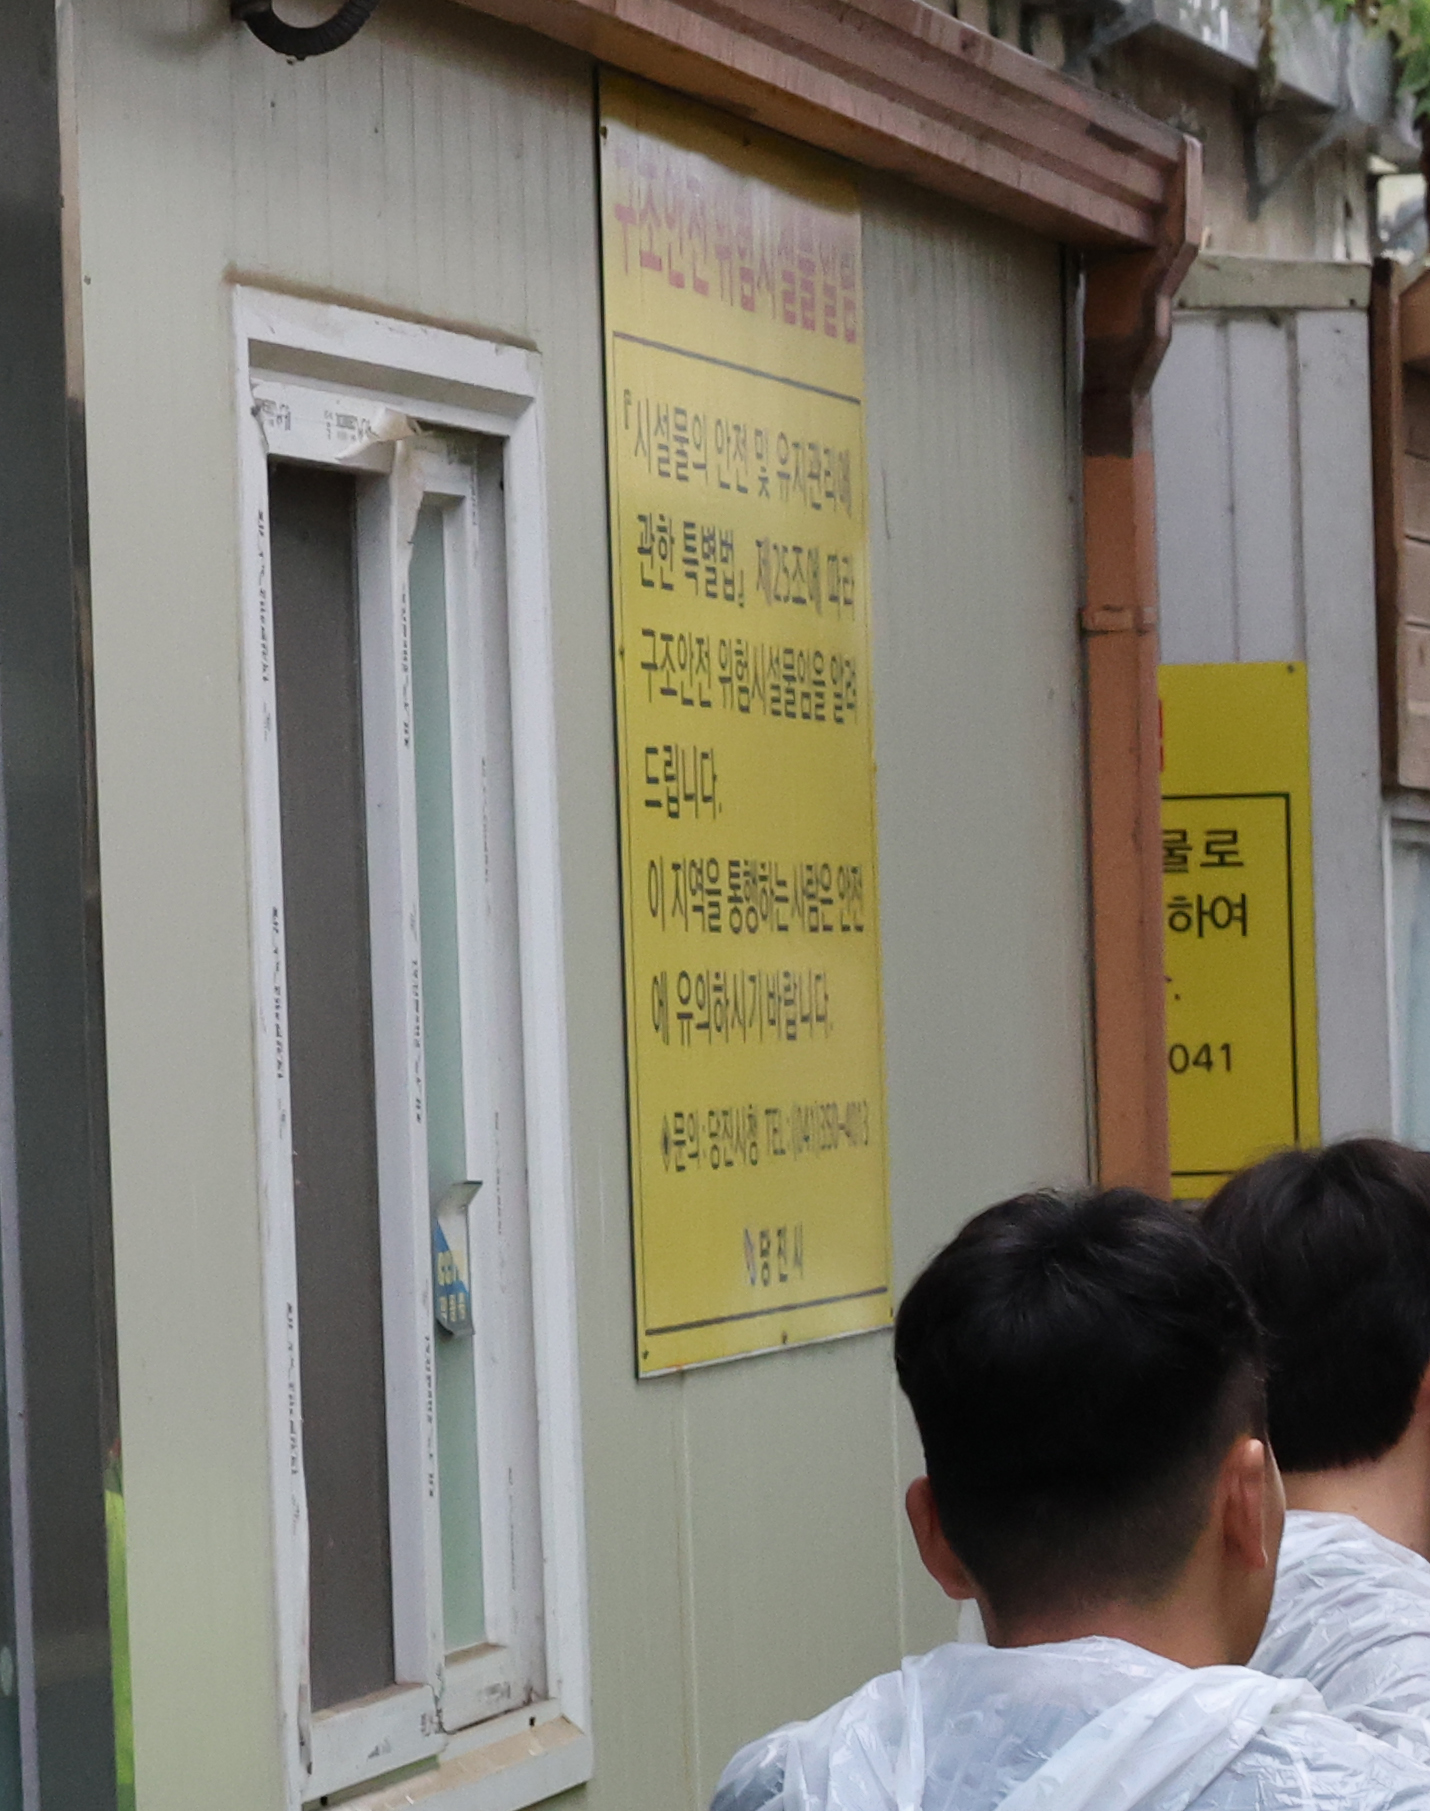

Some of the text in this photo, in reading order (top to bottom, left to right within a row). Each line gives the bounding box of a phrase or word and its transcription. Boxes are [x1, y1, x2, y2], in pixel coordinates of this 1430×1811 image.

[714, 415, 749, 495] 안전
[756, 427, 770, 500] 및
[775, 429, 852, 518] 유지관리에
[635, 508, 676, 593] 관한
[826, 550, 855, 622] 따라
[639, 624, 857, 726] 구조안전 위험시설물임을 알려
[643, 740, 722, 822] 드립니다.
[646, 855, 864, 935] 이 지역을 통행하는 사람은 안전
[650, 969, 833, 1048] 에 유의하시기 바랍니다.
[1168, 1042, 1234, 1075] 041
